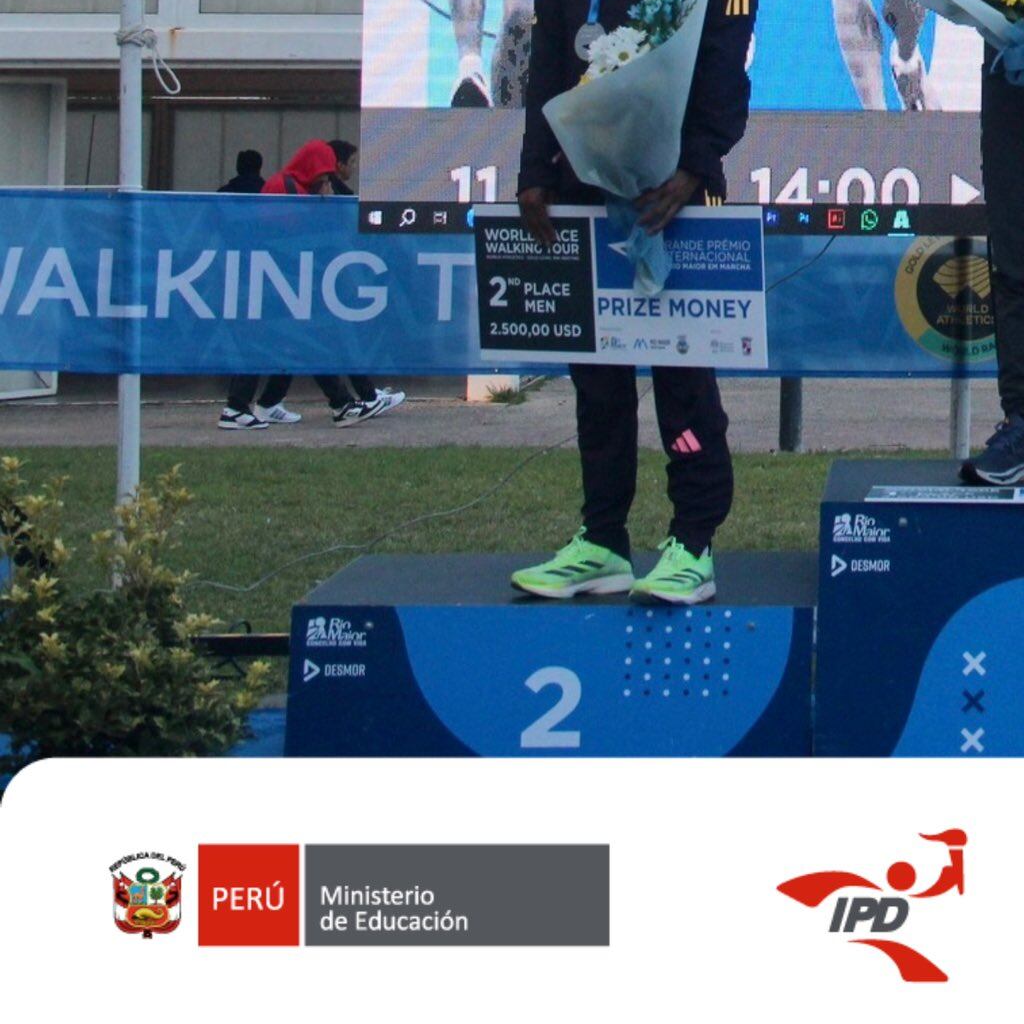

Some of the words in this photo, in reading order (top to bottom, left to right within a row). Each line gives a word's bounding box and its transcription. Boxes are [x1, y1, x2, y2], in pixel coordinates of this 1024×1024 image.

[664, 239, 705, 252] RANDE
[706, 237, 752, 252] PRÉMIO
[0, 246, 389, 322] ALKING
[523, 282, 571, 297] PLACE
[524, 298, 556, 314] MEN
[597, 296, 662, 317] PRIZE
[669, 298, 752, 319] MONEY
[490, 321, 551, 339] 2.500,00
[553, 323, 582, 337] USD
[851, 559, 891, 572] DESMOR
[324, 663, 366, 677] DESMOR
[519, 665, 583, 749] 2
